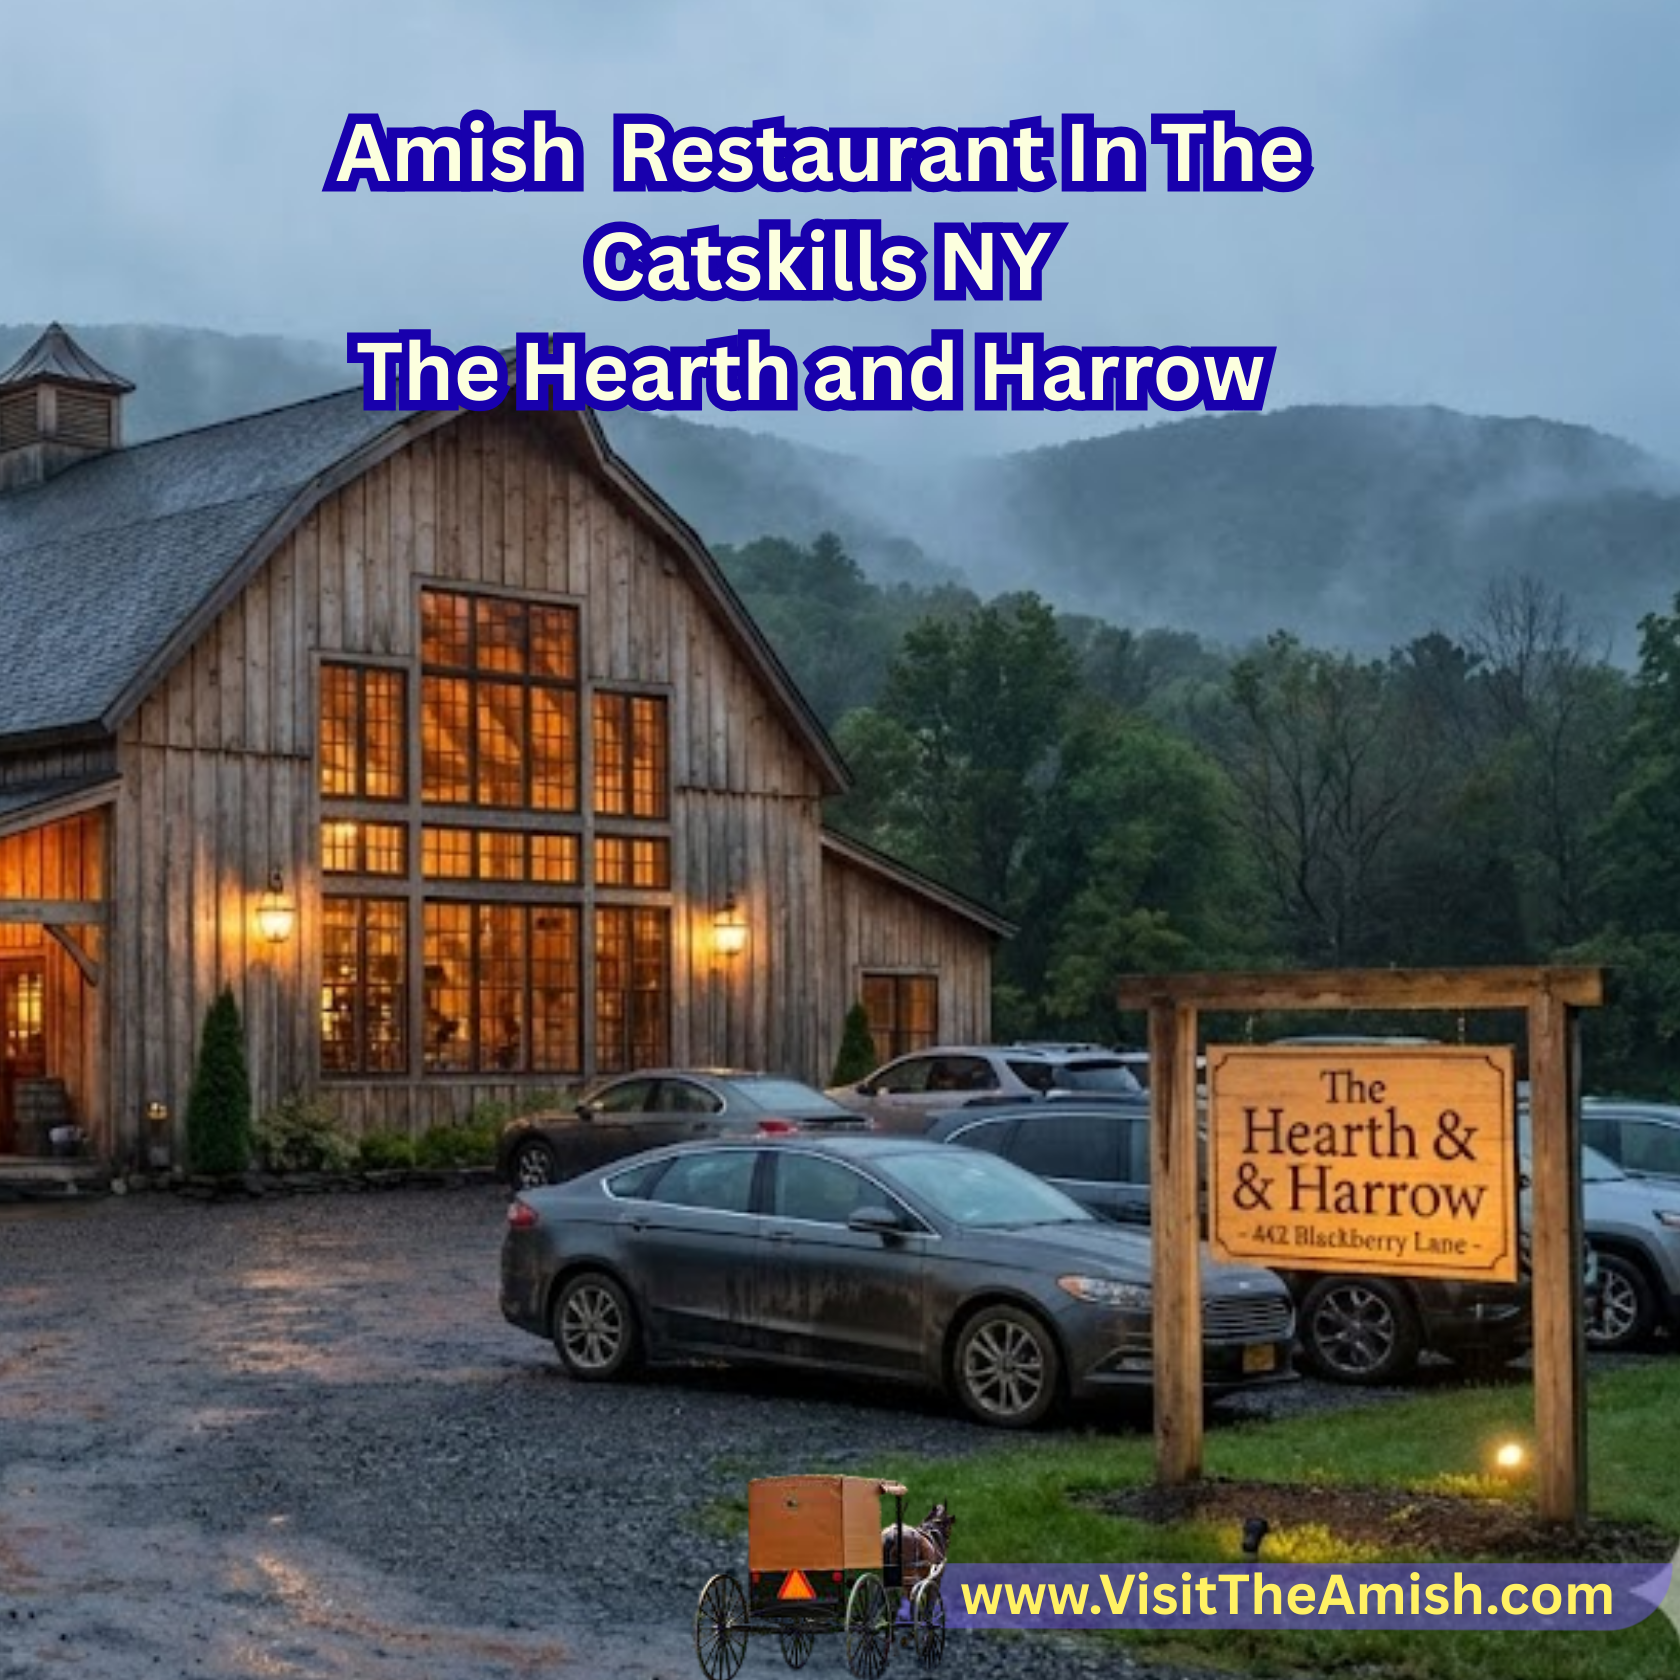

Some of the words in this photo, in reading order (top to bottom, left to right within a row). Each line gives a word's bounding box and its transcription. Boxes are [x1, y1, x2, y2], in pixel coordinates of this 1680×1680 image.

[1320, 1068, 1387, 1104] The
[1242, 1106, 1419, 1159] Hearth
[1432, 1108, 1479, 1161] &
[1232, 1161, 1275, 1211] &
[1287, 1163, 1489, 1221] Harrow
[1294, 1225, 1407, 1257] Blackberry
[1414, 1231, 1468, 1254] Lane
